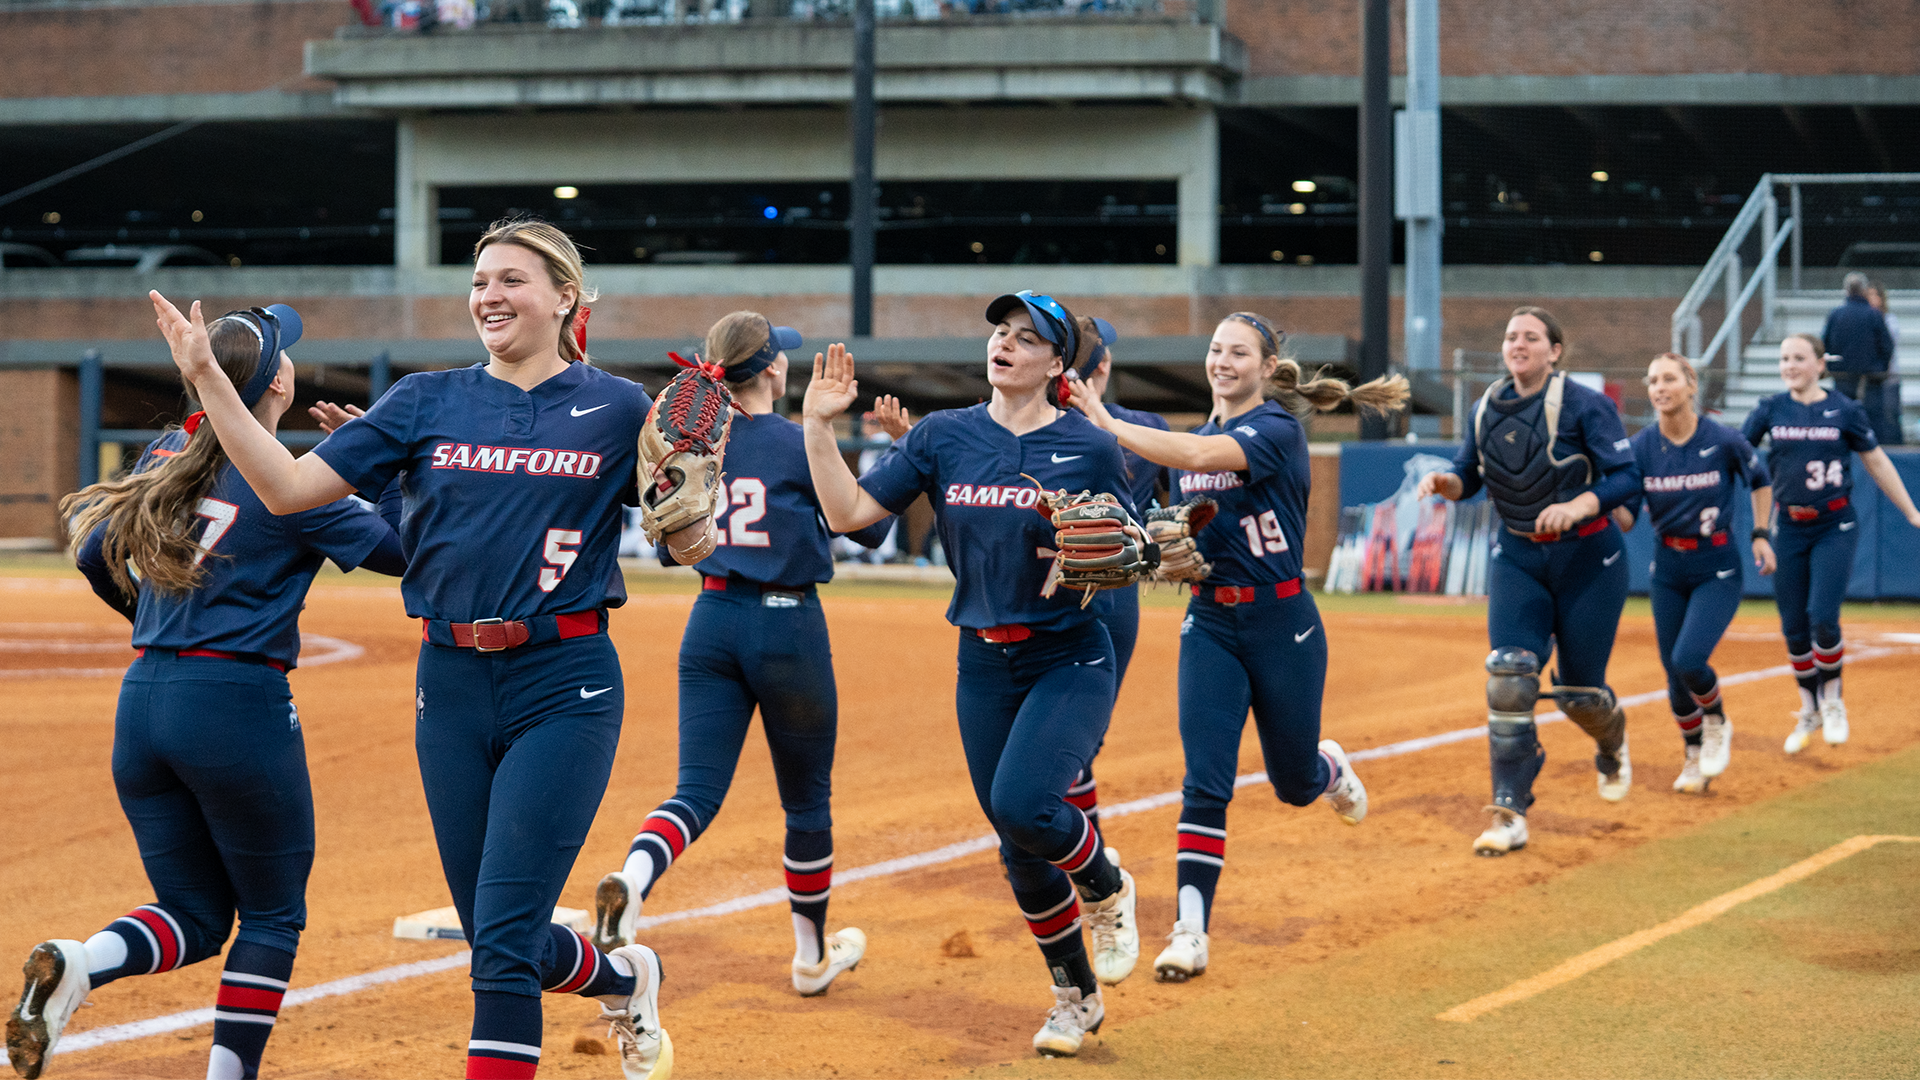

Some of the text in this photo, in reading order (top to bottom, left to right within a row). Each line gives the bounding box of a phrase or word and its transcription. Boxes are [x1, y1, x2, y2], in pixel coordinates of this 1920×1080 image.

[1770, 425, 1840, 441] SAMFORD
[431, 443, 602, 479] SAMFORD
[1805, 459, 1843, 491] 34
[1179, 471, 1244, 493] AMFOR
[1643, 470, 1721, 492] SAMFORD
[945, 483, 1060, 509] SAMFO
[1239, 509, 1289, 557] 19
[537, 528, 582, 593] 5
